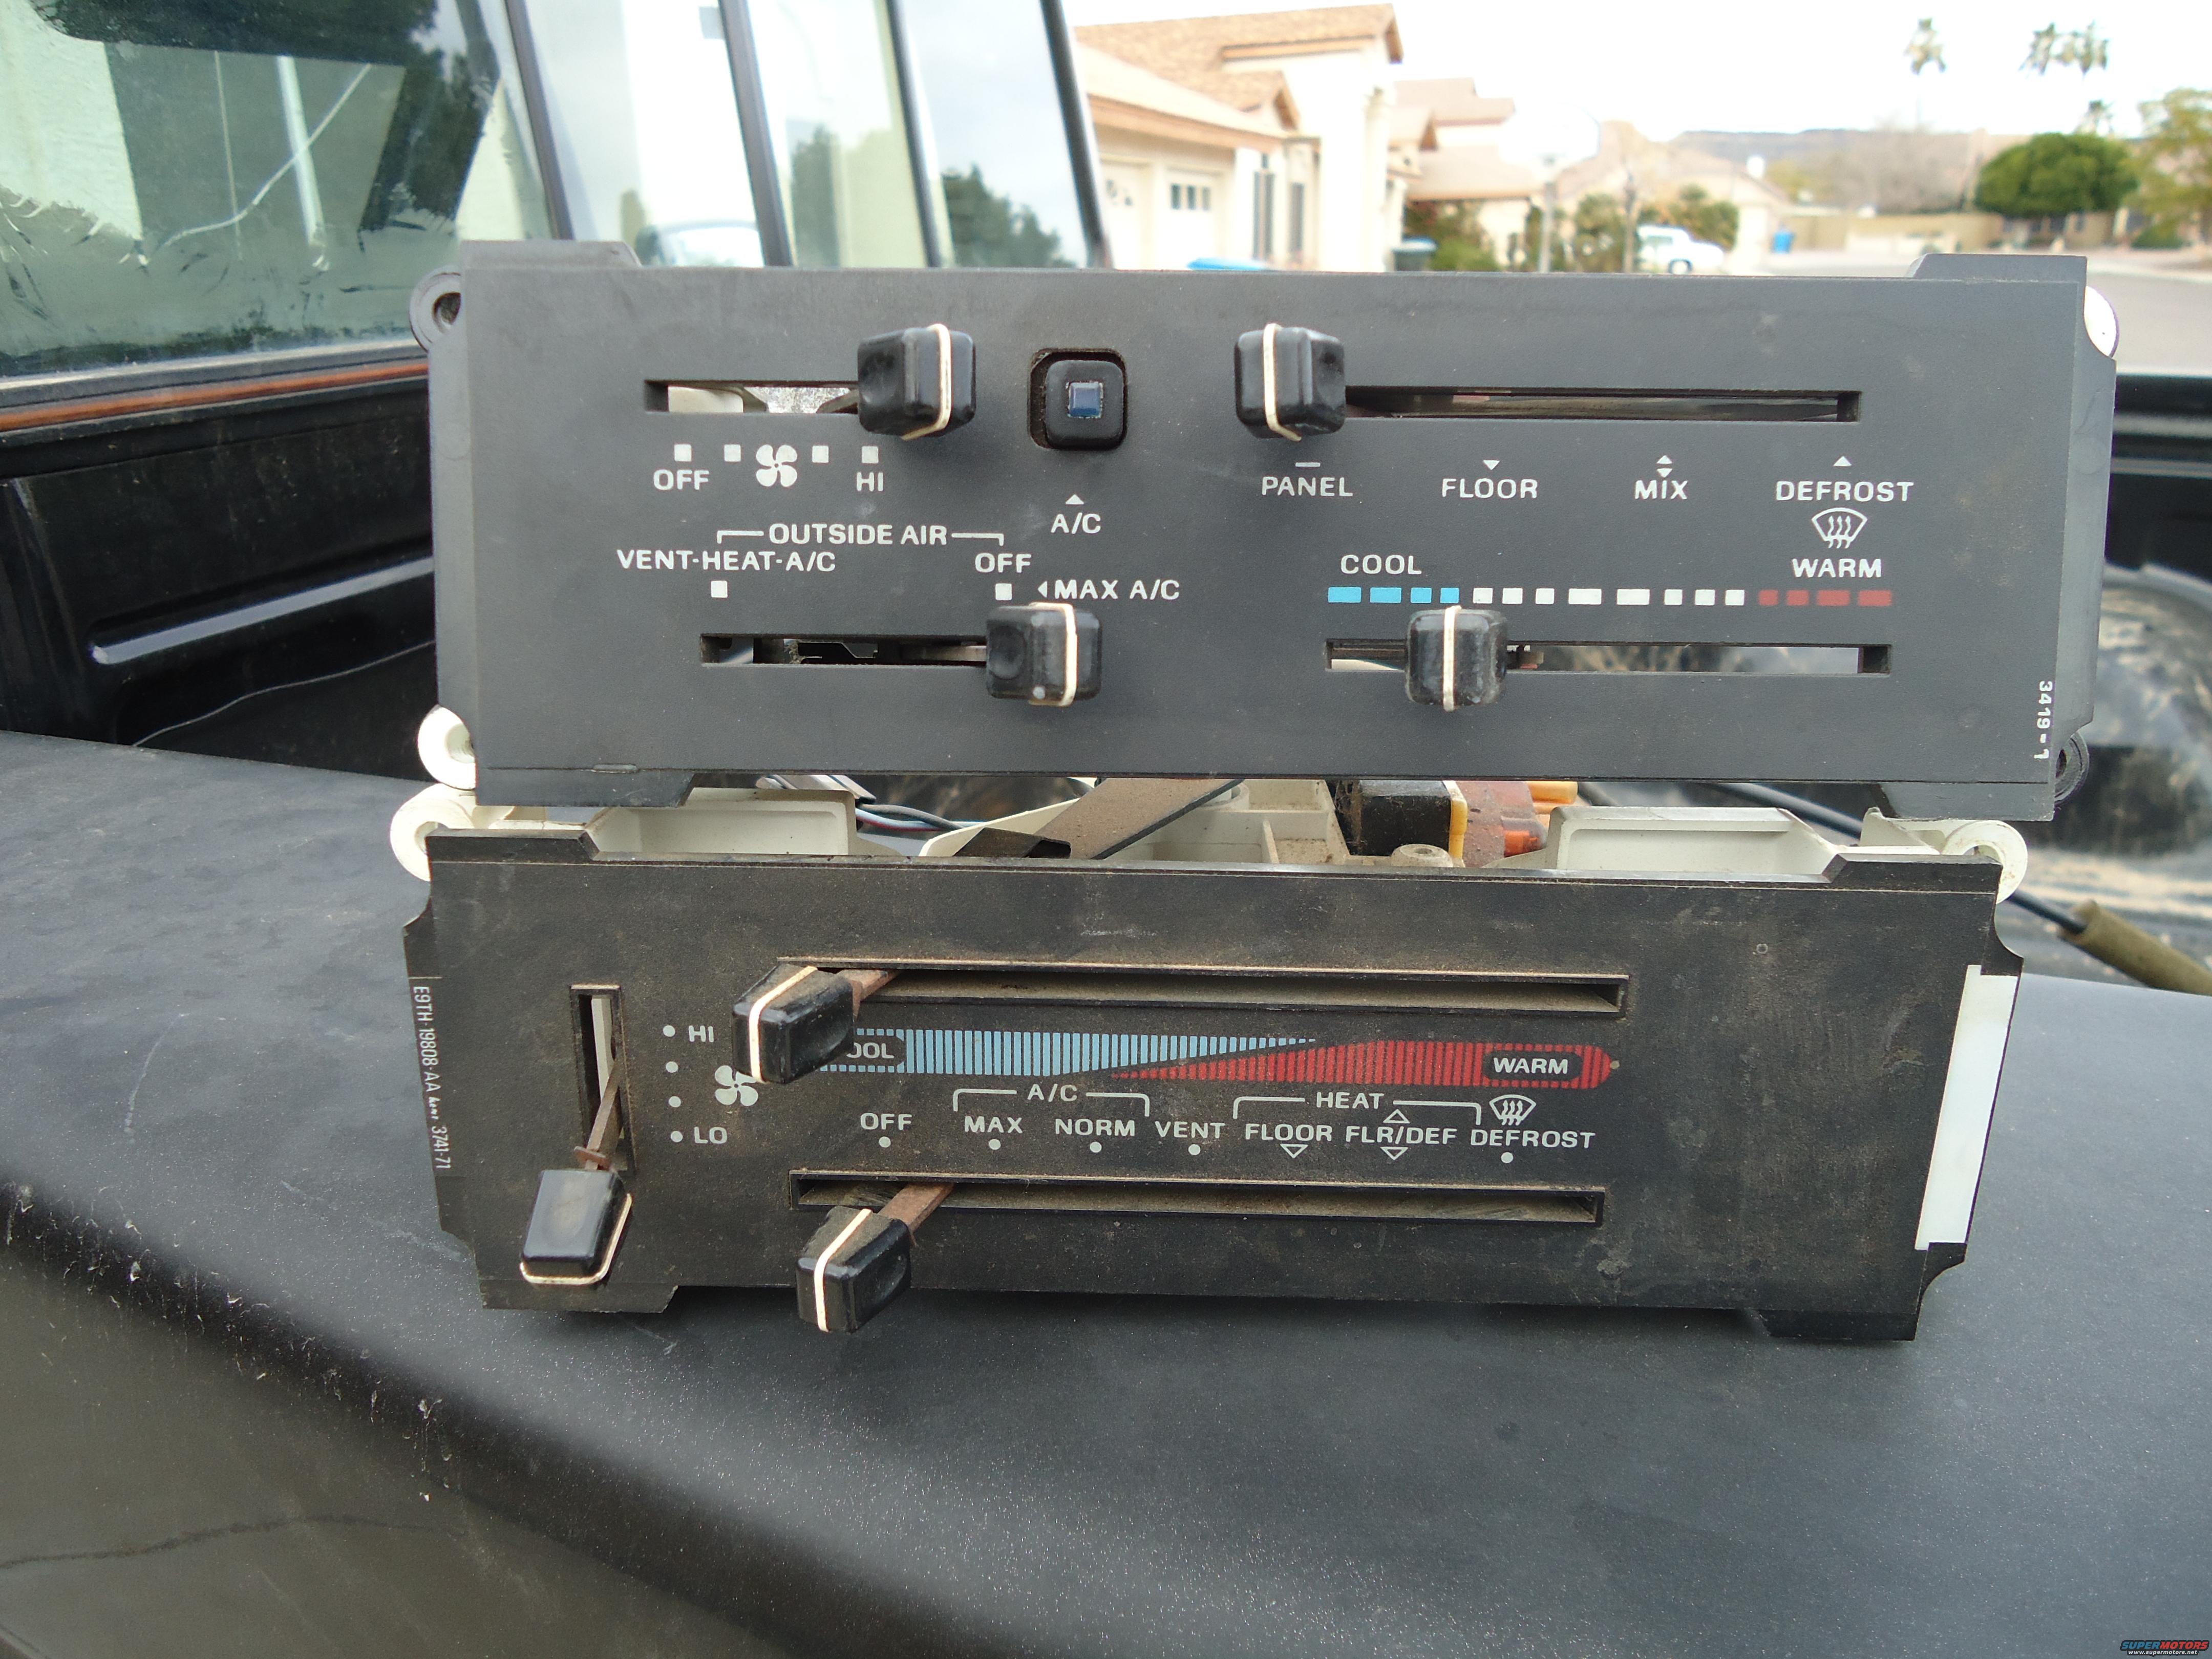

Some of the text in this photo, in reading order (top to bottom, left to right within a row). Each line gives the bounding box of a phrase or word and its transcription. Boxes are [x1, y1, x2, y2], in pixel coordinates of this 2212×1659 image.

[653, 469, 710, 491] OFF
[856, 472, 883, 492] HI
[1262, 476, 1353, 497] PANEL
[1442, 478, 1538, 499] FLOOR
[1634, 480, 1688, 500] MIX
[1776, 481, 1914, 502] DEFROST
[1051, 512, 1101, 534] A/C
[769, 523, 947, 545] OUTSIDE AIR
[616, 549, 836, 572] VENT-HEAT-A/C
[975, 552, 1032, 573] OFF
[1341, 554, 1422, 575] COOL
[1792, 558, 1882, 578] WARM
[1054, 579, 1180, 600] MAX A/C
[2034, 680, 2053, 759] 3419-1
[688, 1025, 714, 1043] HI
[1493, 1057, 1568, 1074] WARM
[1027, 1083, 1077, 1102] A/C
[1316, 1092, 1385, 1109] HEAT
[860, 1113, 912, 1131] OFF
[964, 1116, 1023, 1134] MAX
[1055, 1118, 1135, 1137] NORM
[1155, 1121, 1225, 1139] VENT
[1245, 1123, 1332, 1141] FLOOR
[694, 1126, 728, 1144] LO
[1346, 1125, 1457, 1144] FLR/DEF
[1470, 1129, 1596, 1148] DEFROST
[431, 1126, 451, 1168] 3741-71
